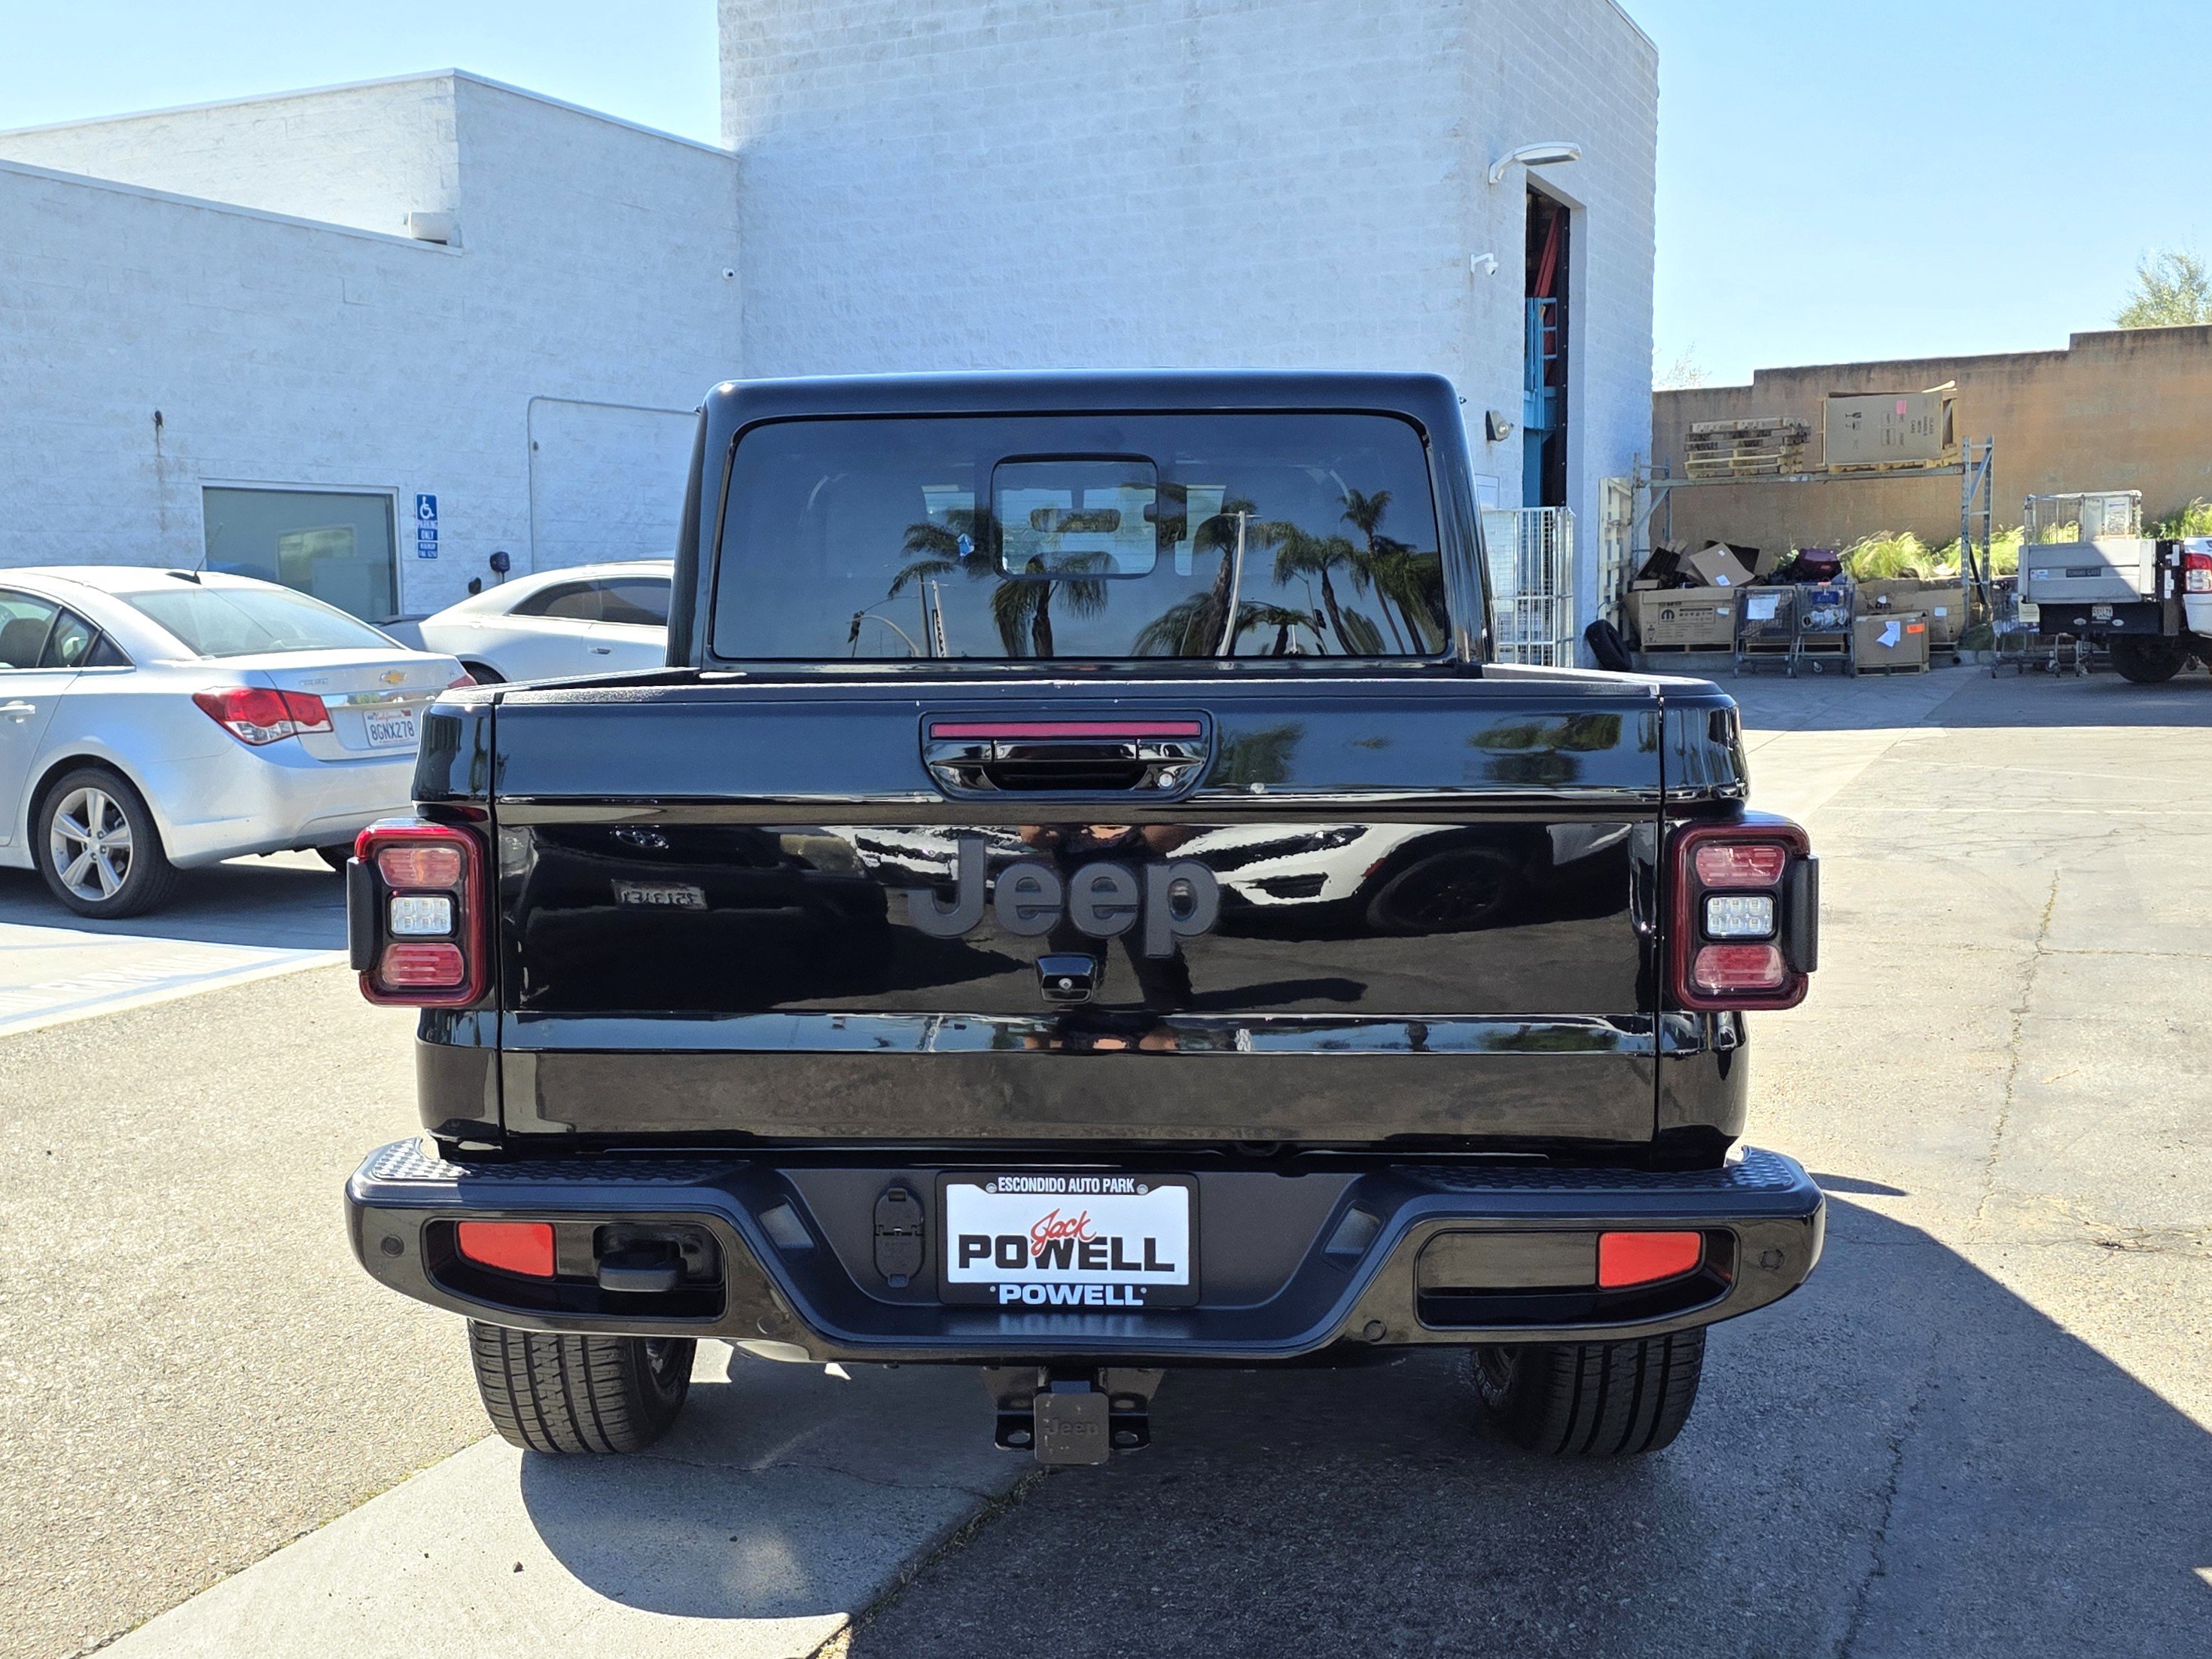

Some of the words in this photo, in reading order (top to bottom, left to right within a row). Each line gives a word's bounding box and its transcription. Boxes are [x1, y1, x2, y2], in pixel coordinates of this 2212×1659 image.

[370, 721, 414, 741] 8GNX278
[907, 837, 1220, 959] Jeep
[998, 1177, 1065, 1193] ESCONDIDO
[1068, 1178, 1100, 1193] AUTO
[1103, 1179, 1135, 1194] PARK
[1031, 1208, 1097, 1257] Jack
[958, 1235, 1175, 1272] POWELL
[999, 1284, 1144, 1306] POWELL
[1044, 1417, 1100, 1438] Jeep
